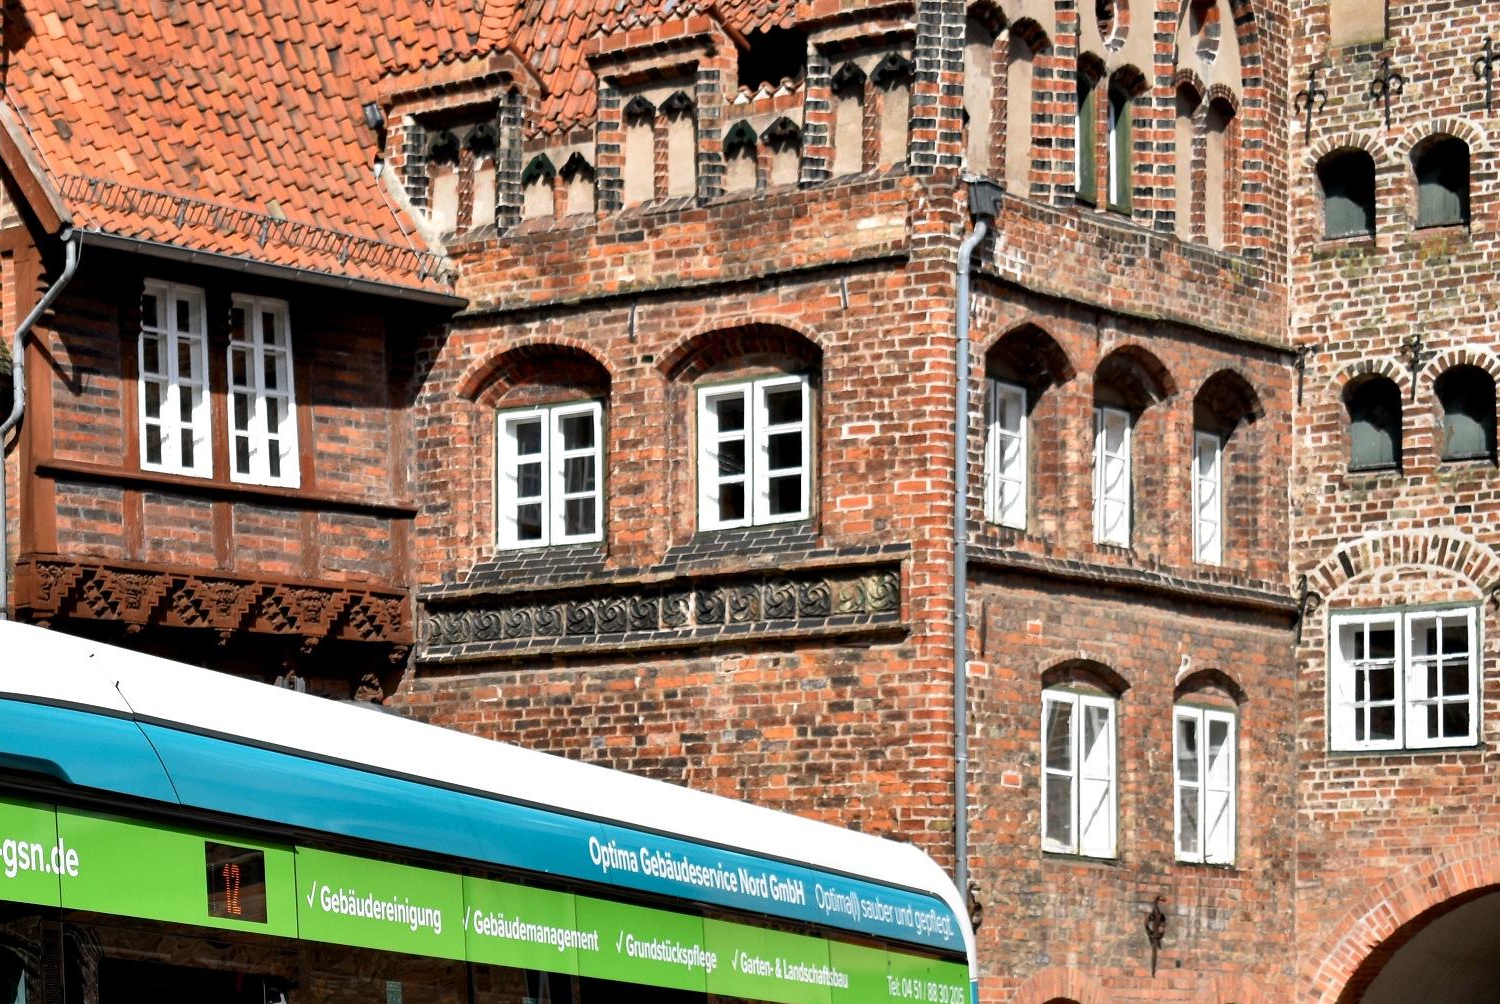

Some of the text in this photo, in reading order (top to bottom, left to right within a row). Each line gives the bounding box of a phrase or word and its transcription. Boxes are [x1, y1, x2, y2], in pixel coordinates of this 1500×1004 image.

[222, 863, 242, 915] 12
[588, 836, 805, 906] Optima Gebäudeservice Nord GmbH
[320, 884, 442, 934] Gebäudereinigung
[861, 897, 893, 923] sauber
[895, 905, 914, 928] und
[473, 909, 599, 952] Gebäudemanagement
[626, 934, 717, 974] Grundstückspflege
[740, 952, 849, 989] Garten- & Landschaftsbau
[902, 977, 912, 998] 04
[913, 980, 922, 1000] 51
[927, 982, 938, 1003] 88
[938, 984, 949, 1004] 30
